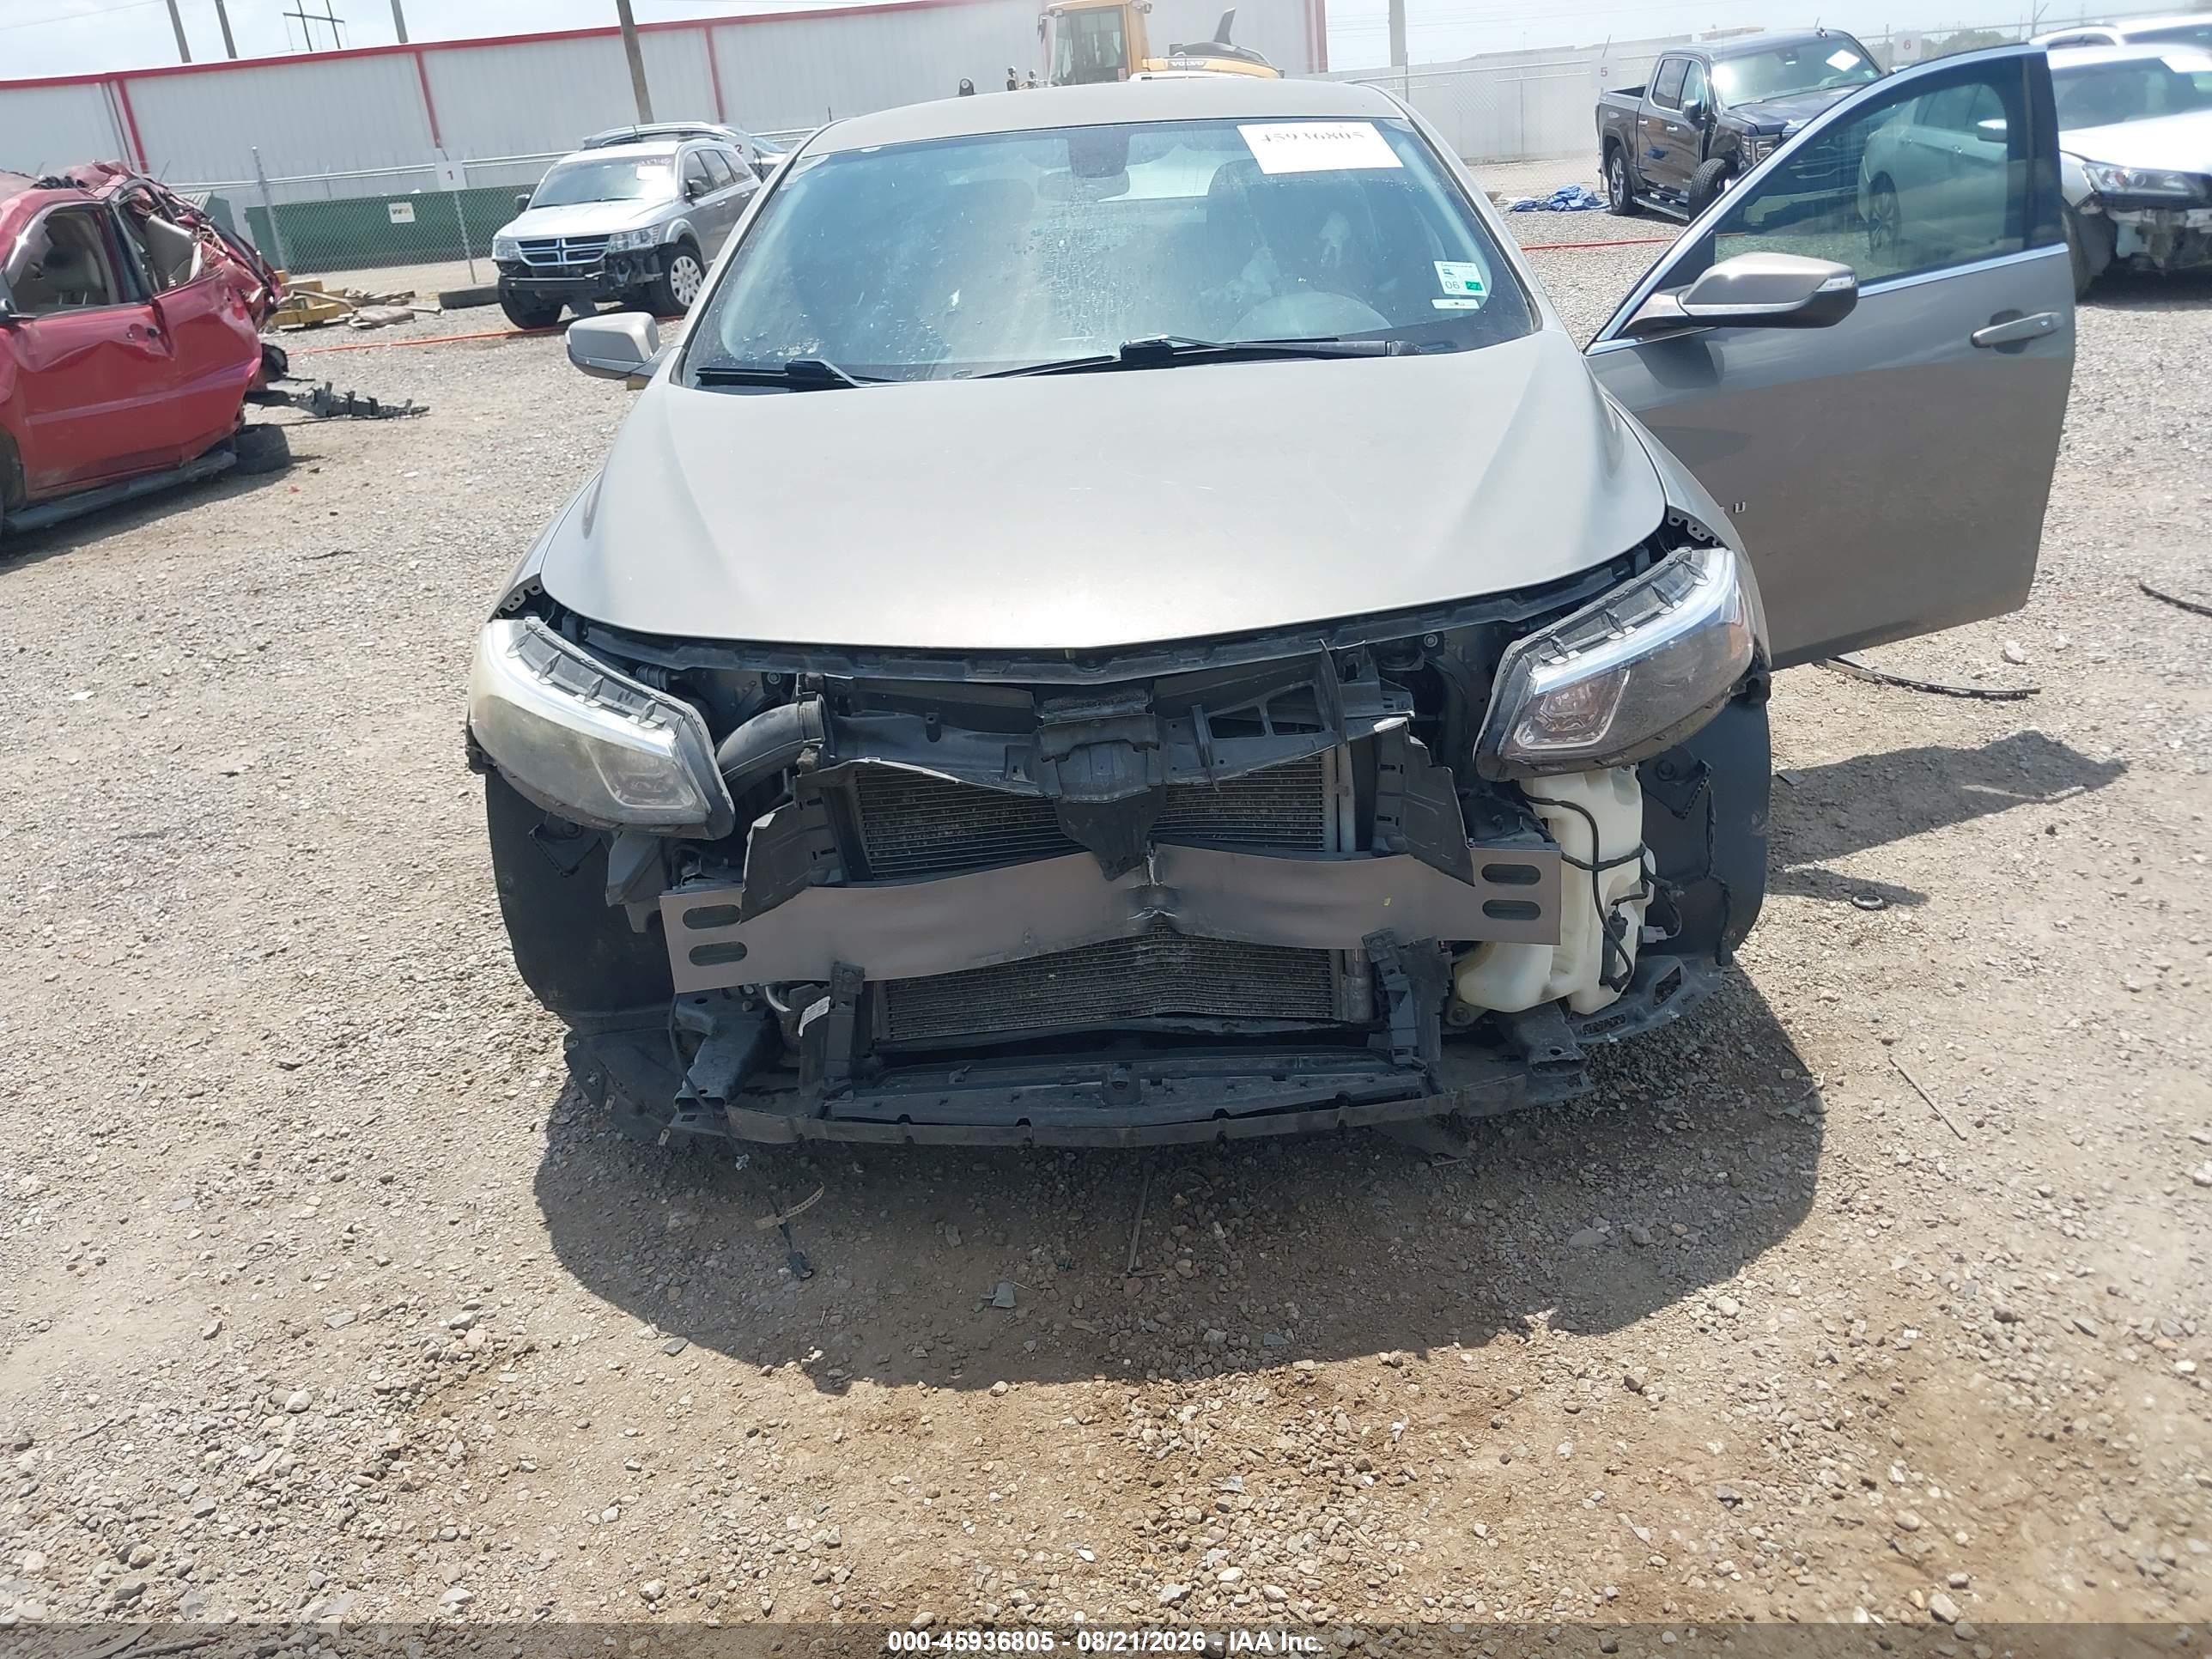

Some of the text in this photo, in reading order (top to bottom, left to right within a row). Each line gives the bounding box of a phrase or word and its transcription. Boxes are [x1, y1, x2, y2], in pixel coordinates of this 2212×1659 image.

[1903, 40, 1911, 50] 6
[1600, 66, 1608, 77] 5
[734, 143, 744, 155] 2
[447, 170, 453, 180] 1
